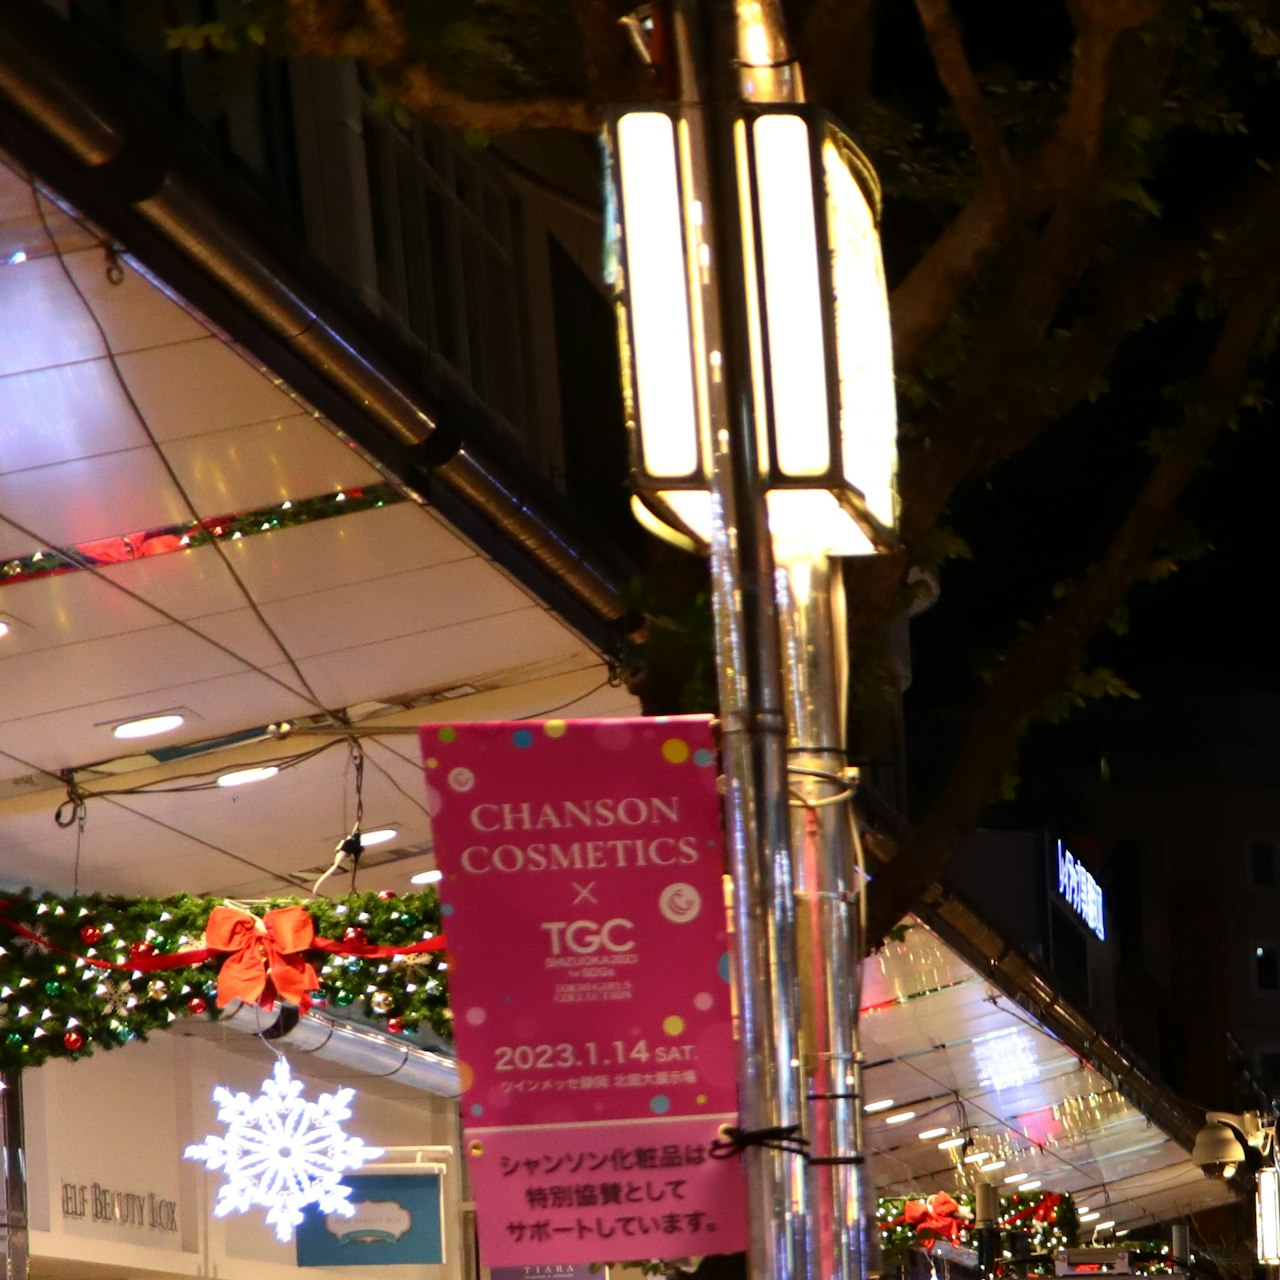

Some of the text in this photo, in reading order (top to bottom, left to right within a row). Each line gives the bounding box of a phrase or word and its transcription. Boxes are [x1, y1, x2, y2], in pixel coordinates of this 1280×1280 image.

[470, 797, 680, 832] CHANSON
[460, 837, 699, 873] COSMETICS
[541, 918, 635, 955] TGC
[495, 1040, 698, 1071] 2023.1.14 SAT.
[500, 1144, 706, 1177] シャンソン化粧品は
[526, 1180, 687, 1209] 特別協賛として
[507, 1211, 718, 1242] サポートしています。
[524, 1264, 574, 1274] TIARA
